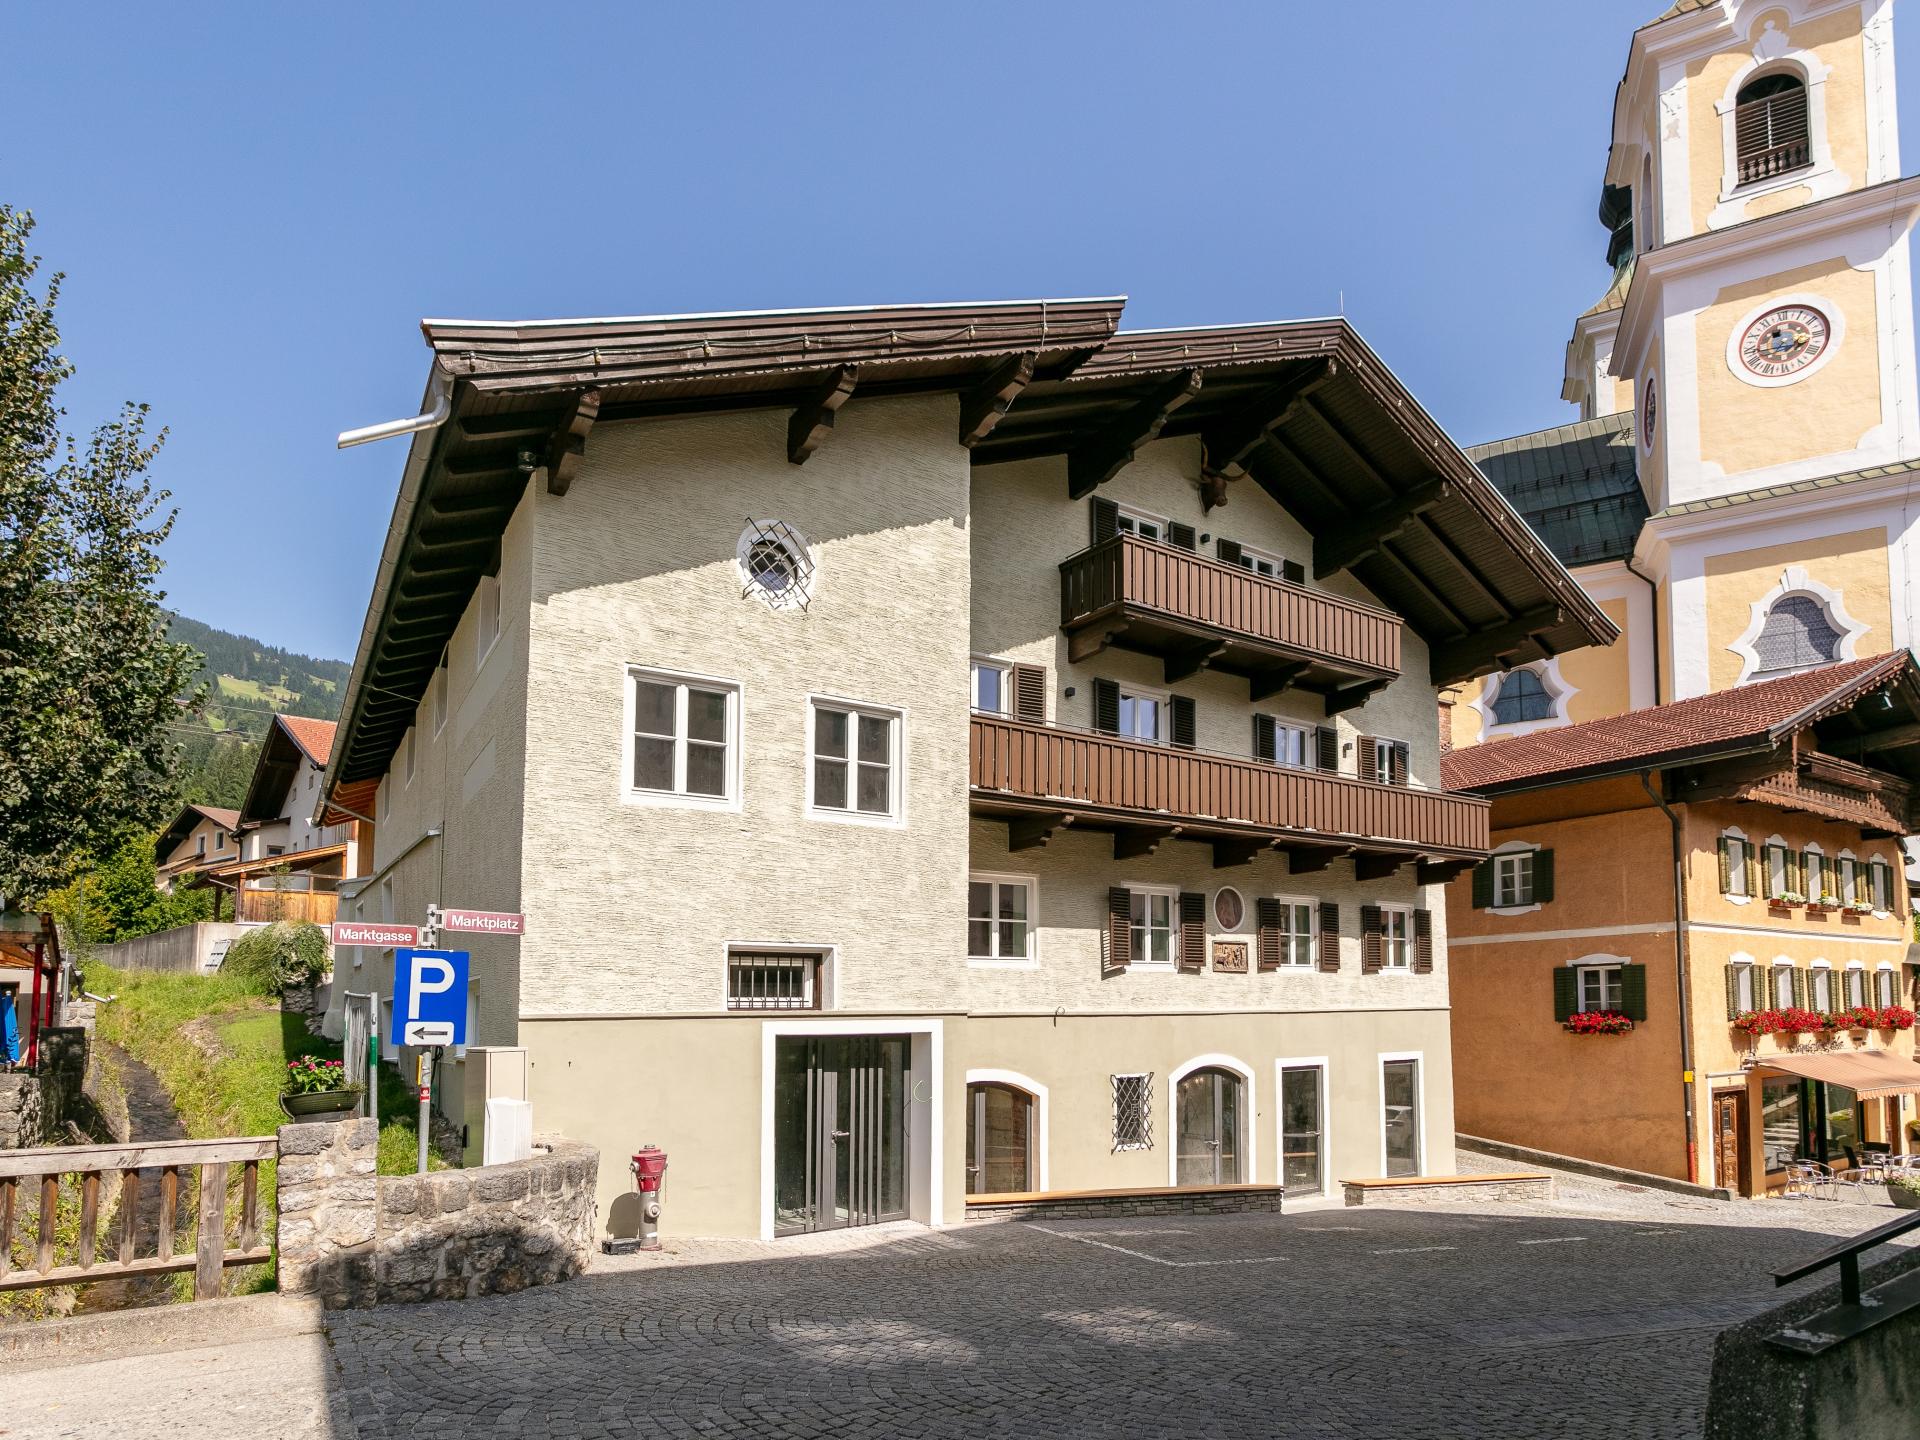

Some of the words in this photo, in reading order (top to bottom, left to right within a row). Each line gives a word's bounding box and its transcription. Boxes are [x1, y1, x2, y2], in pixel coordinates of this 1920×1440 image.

[451, 915, 519, 930] Marktplatz
[339, 929, 413, 942] Marktgasse
[408, 957, 455, 1020] P
